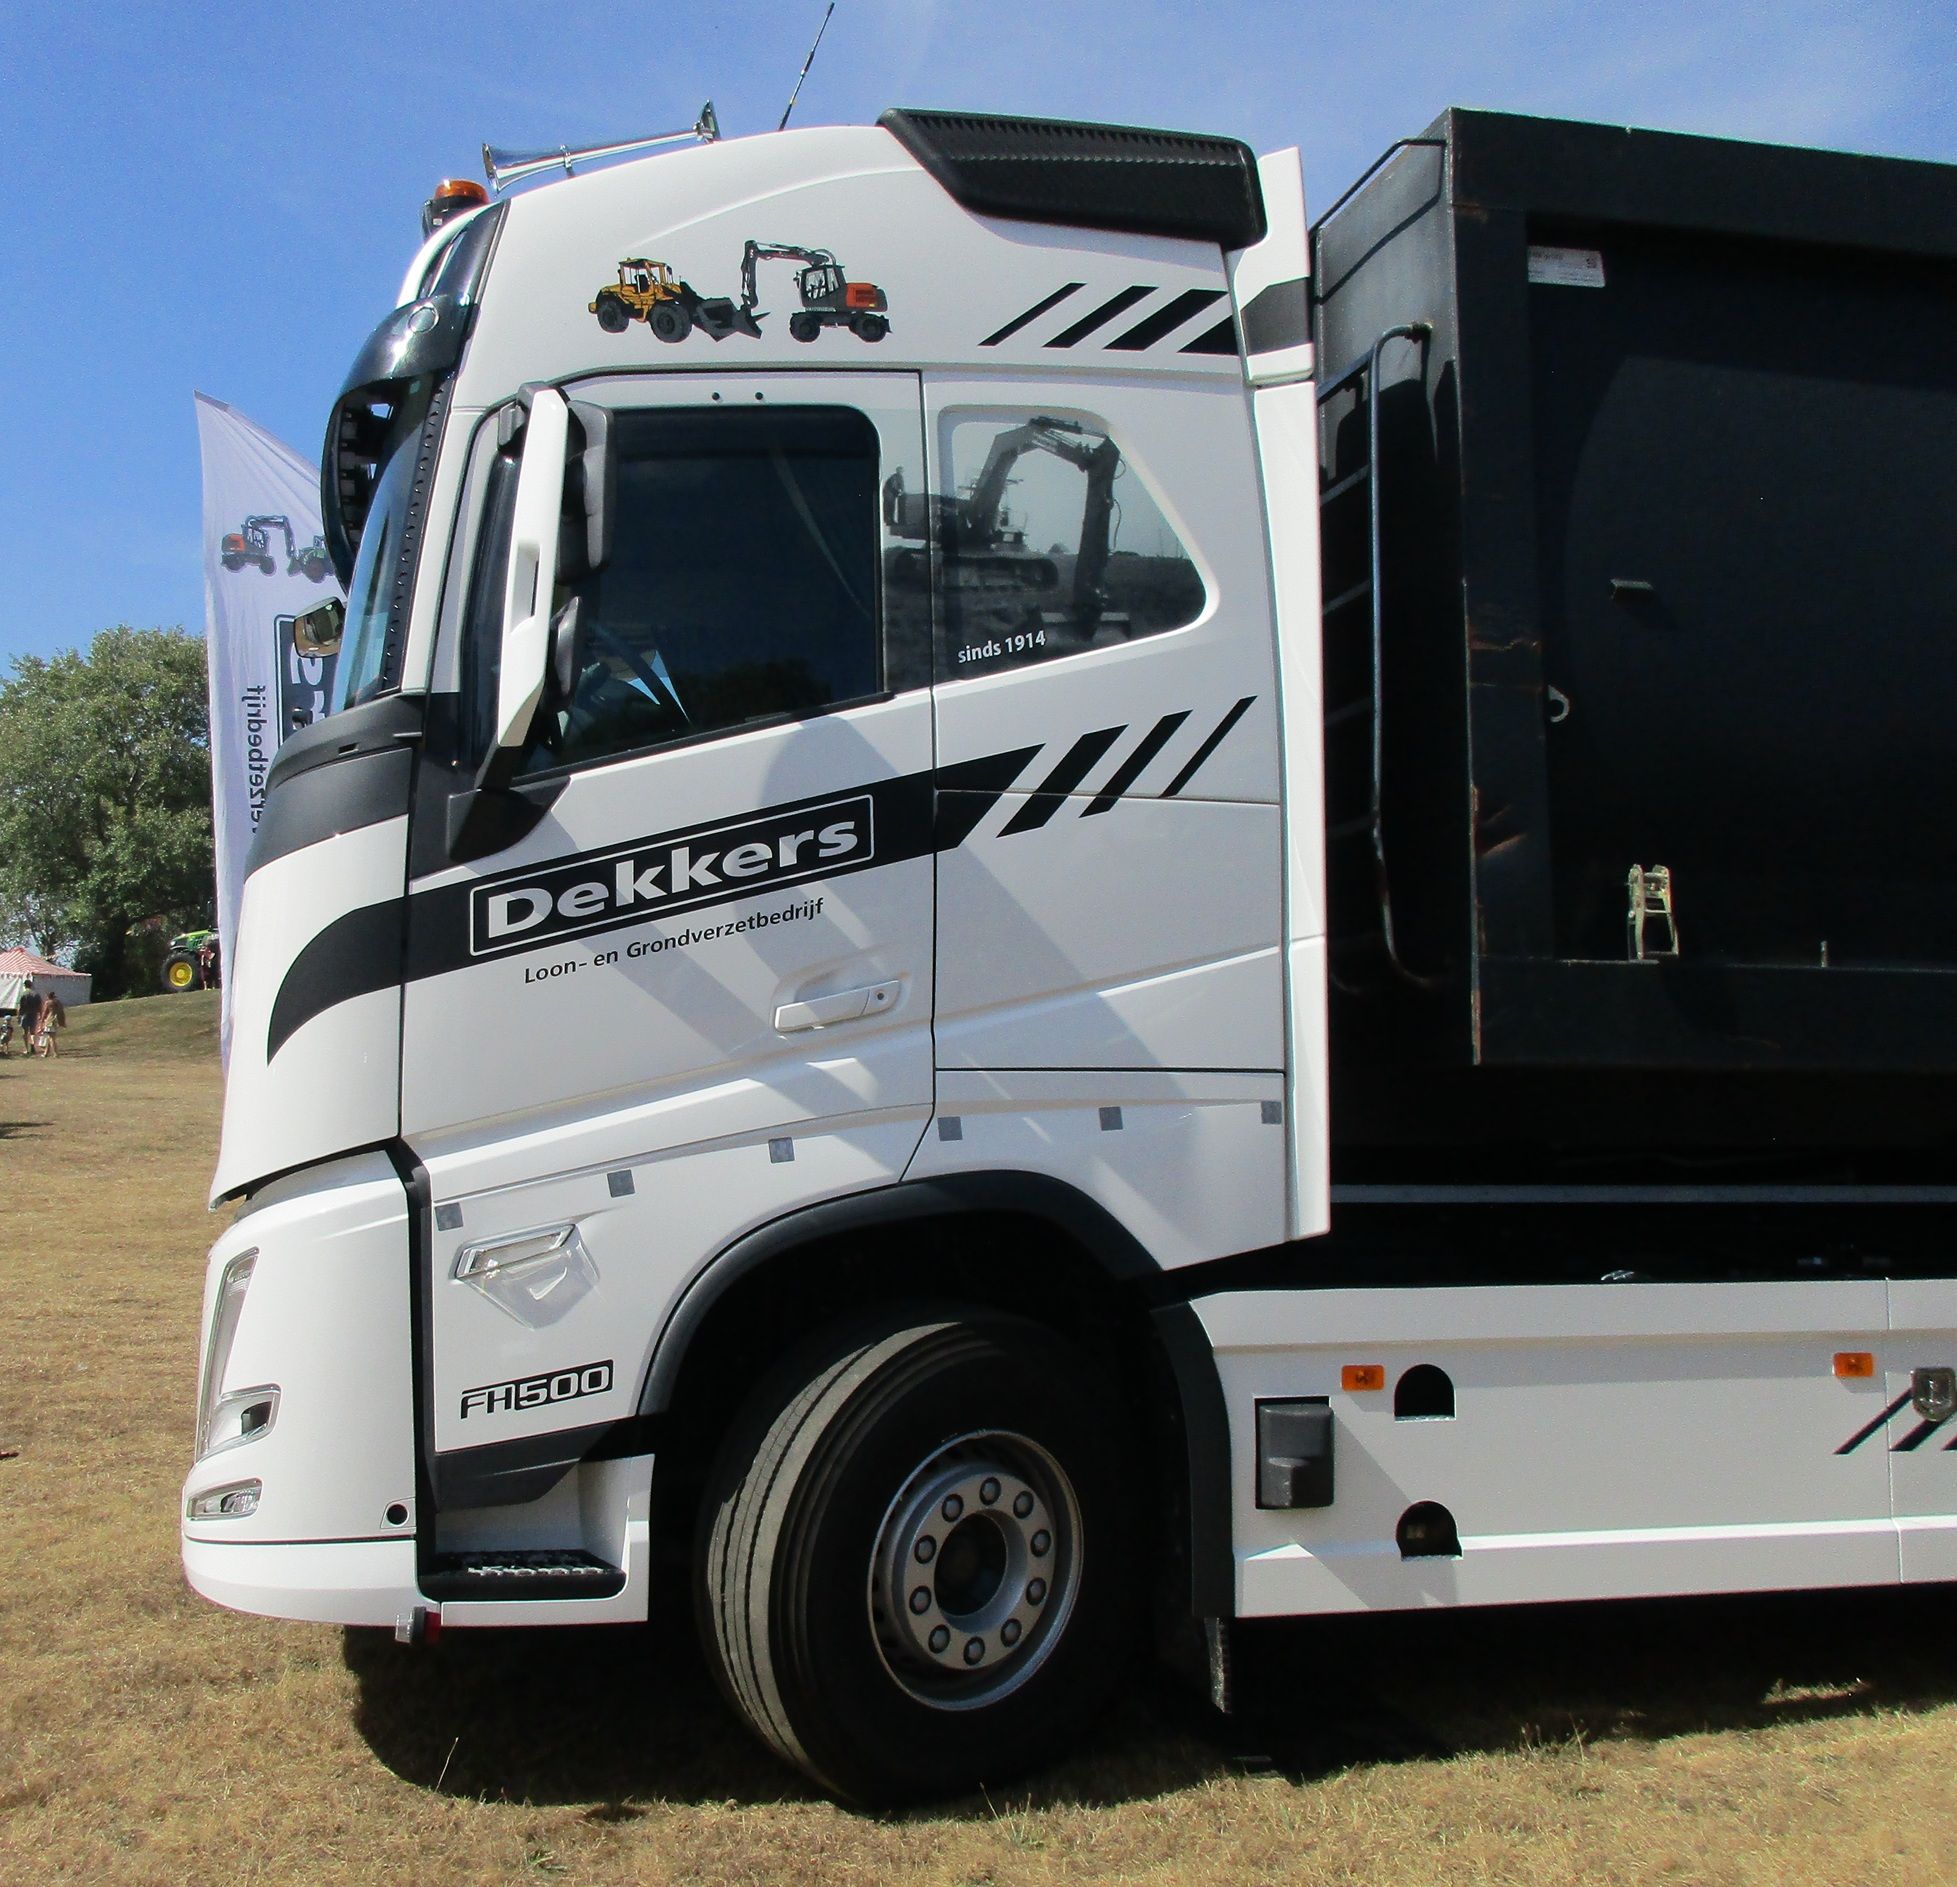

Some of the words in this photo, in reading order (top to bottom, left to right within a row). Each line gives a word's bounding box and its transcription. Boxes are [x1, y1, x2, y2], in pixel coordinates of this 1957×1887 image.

[957, 640, 1002, 663] sinds
[1004, 630, 1046, 653] 1914
[488, 820, 858, 938] Dekkers
[523, 960, 588, 984] Loon-
[593, 949, 619, 966] en
[625, 898, 824, 959] Grondverzetbedrijf
